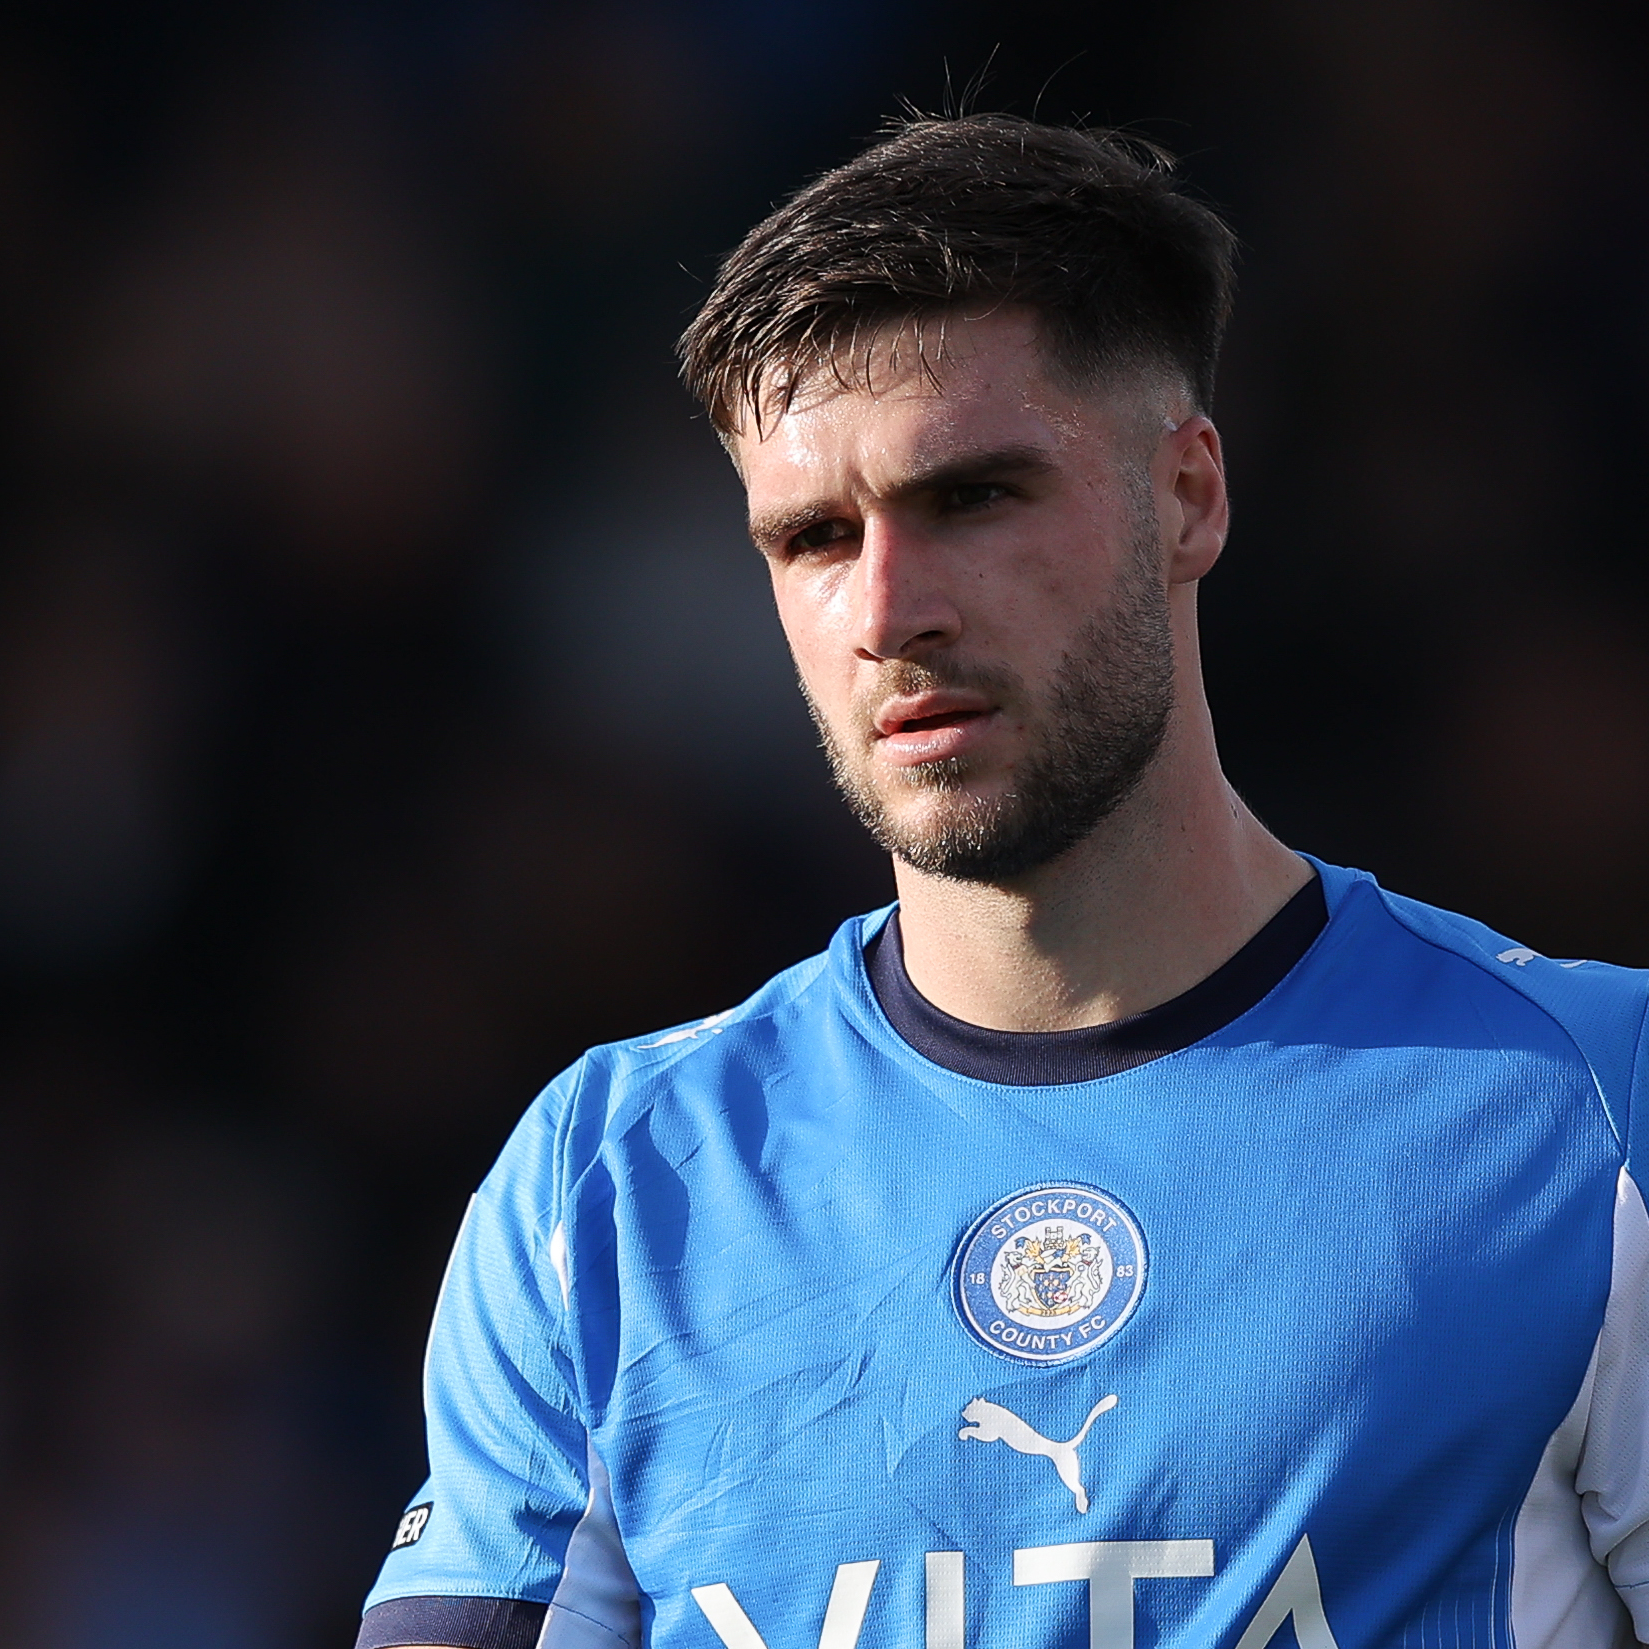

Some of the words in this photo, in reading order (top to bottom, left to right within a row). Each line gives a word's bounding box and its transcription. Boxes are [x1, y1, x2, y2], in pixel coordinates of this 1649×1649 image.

[991, 1199, 1117, 1239] STOCKPORT
[969, 1272, 985, 1285] 18
[1116, 1265, 1134, 1277] 83
[989, 1320, 1073, 1350] COUNTY
[1079, 1315, 1106, 1338] FC
